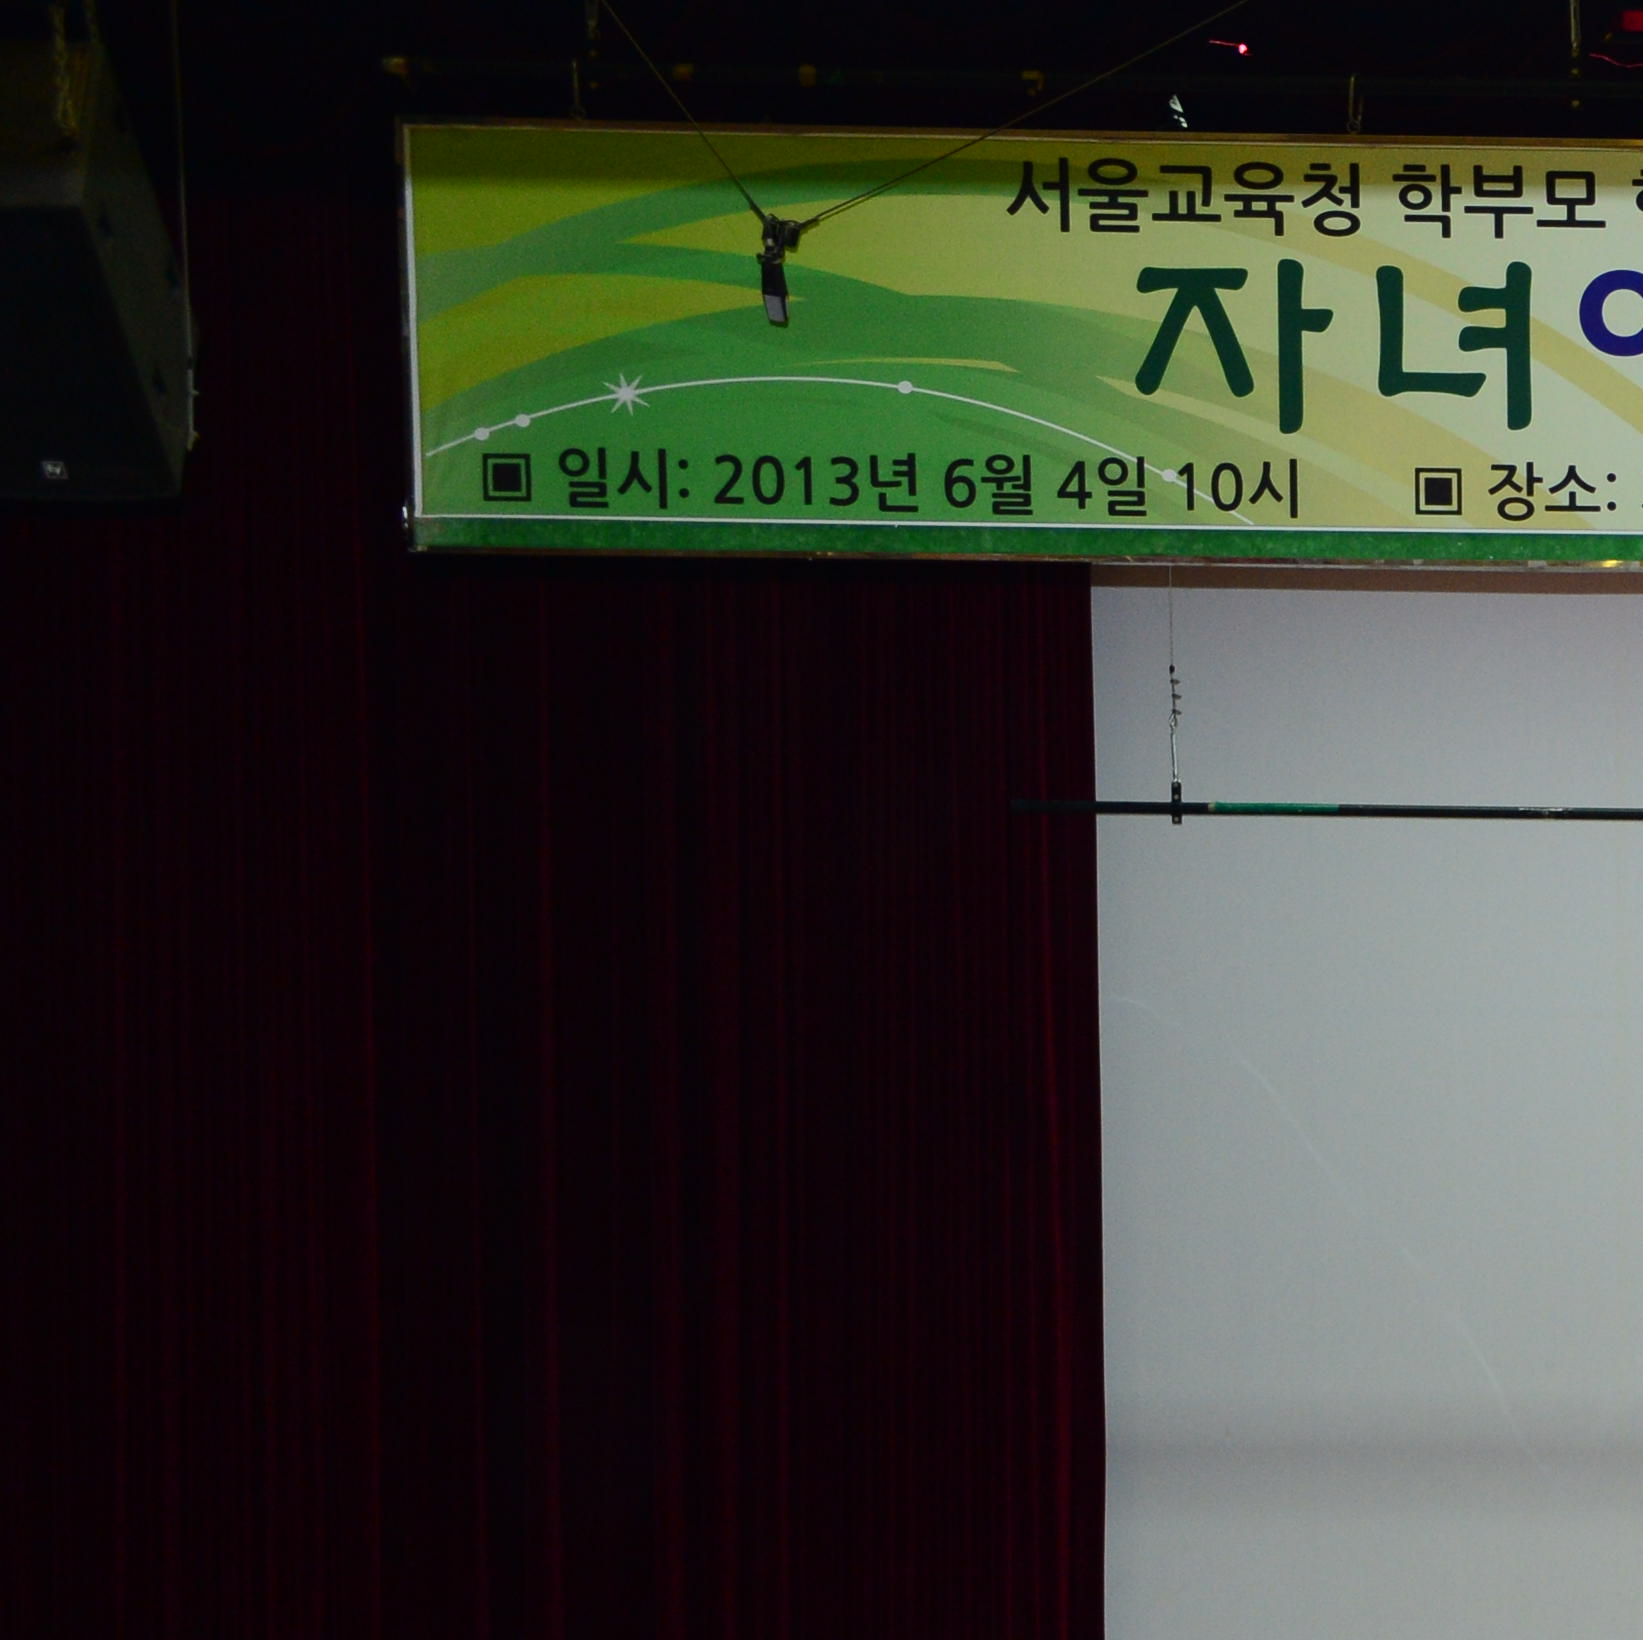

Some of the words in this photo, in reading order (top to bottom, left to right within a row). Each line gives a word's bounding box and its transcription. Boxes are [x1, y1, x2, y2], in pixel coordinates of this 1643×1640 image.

[1006, 156, 1361, 237] 서울교육청
[1391, 163, 1606, 239] 학부모
[558, 446, 690, 510] 일시:
[713, 452, 919, 513] 2013년
[943, 454, 1033, 516] 6월
[1056, 456, 1147, 517] 4일
[1177, 458, 1298, 519] 10시
[1488, 461, 1617, 522] 장소:
